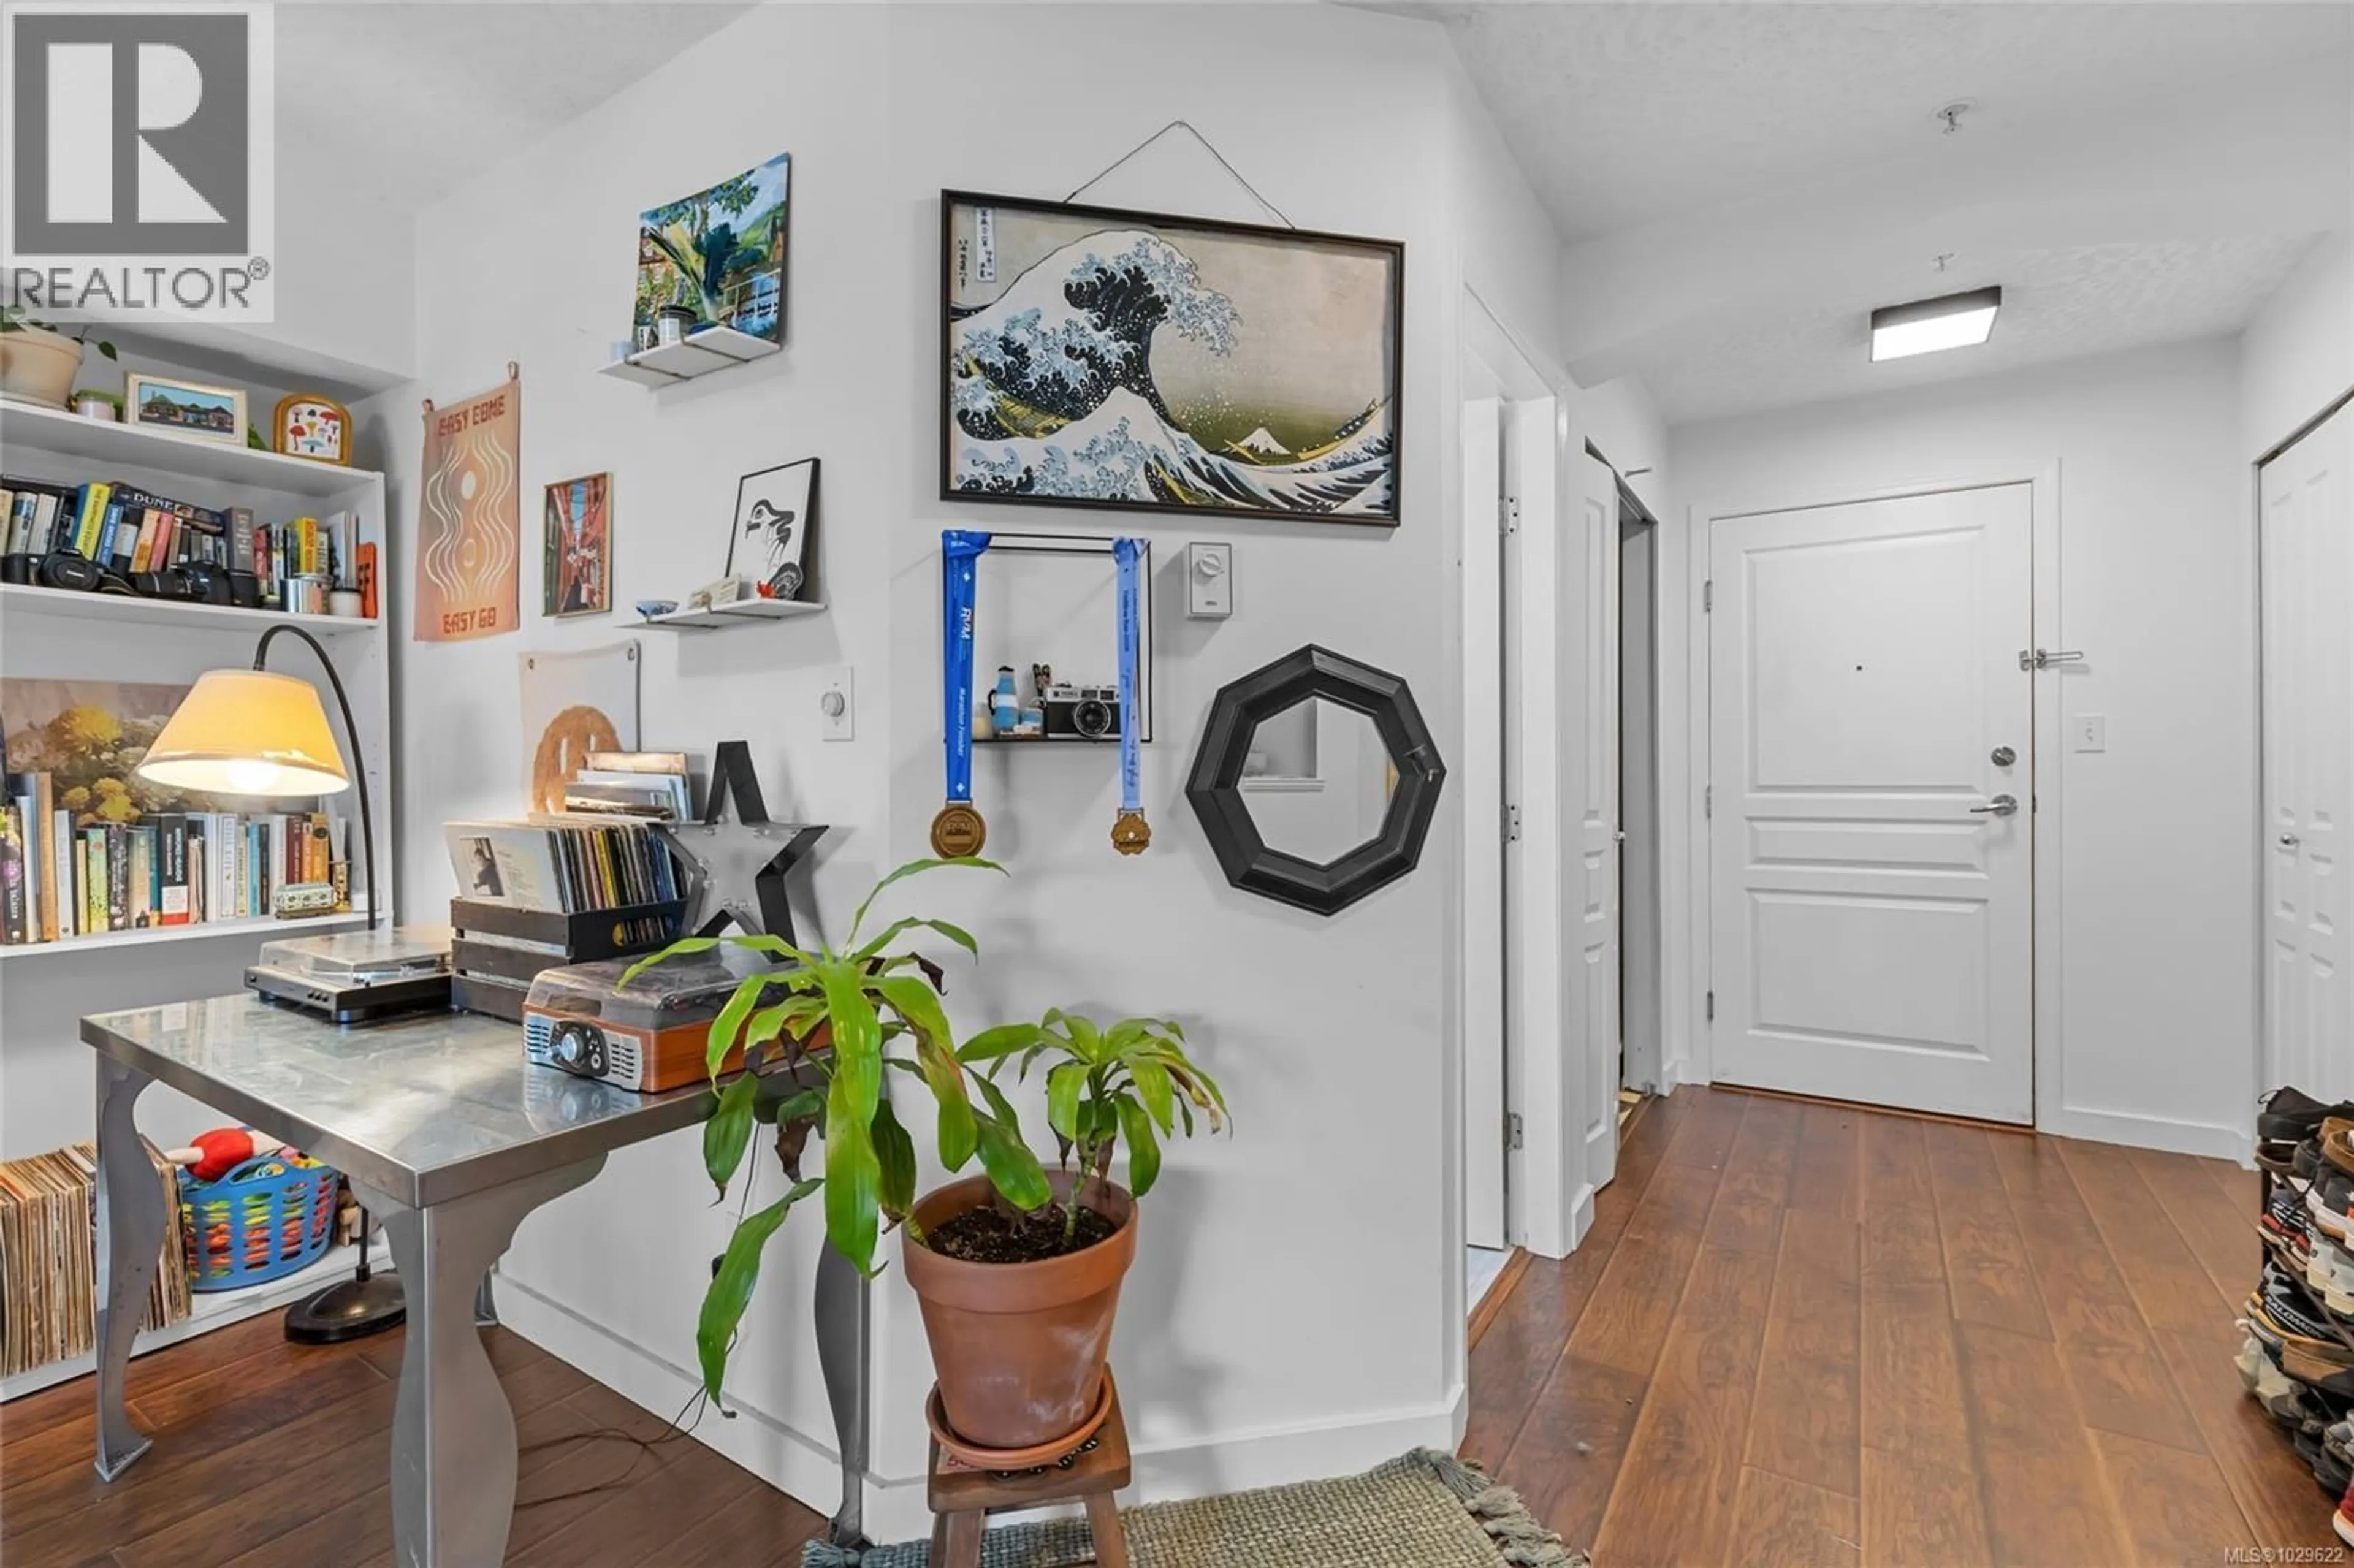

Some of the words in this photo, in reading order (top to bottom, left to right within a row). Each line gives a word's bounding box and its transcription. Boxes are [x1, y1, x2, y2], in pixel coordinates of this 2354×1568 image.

[438, 409, 469, 436] EASY
[472, 395, 505, 426] COME
[134, 493, 173, 510] DUNE
[443, 610, 476, 634] EASY
[478, 607, 497, 629] GO
[2266, 1295, 2325, 1339] SALOMON
